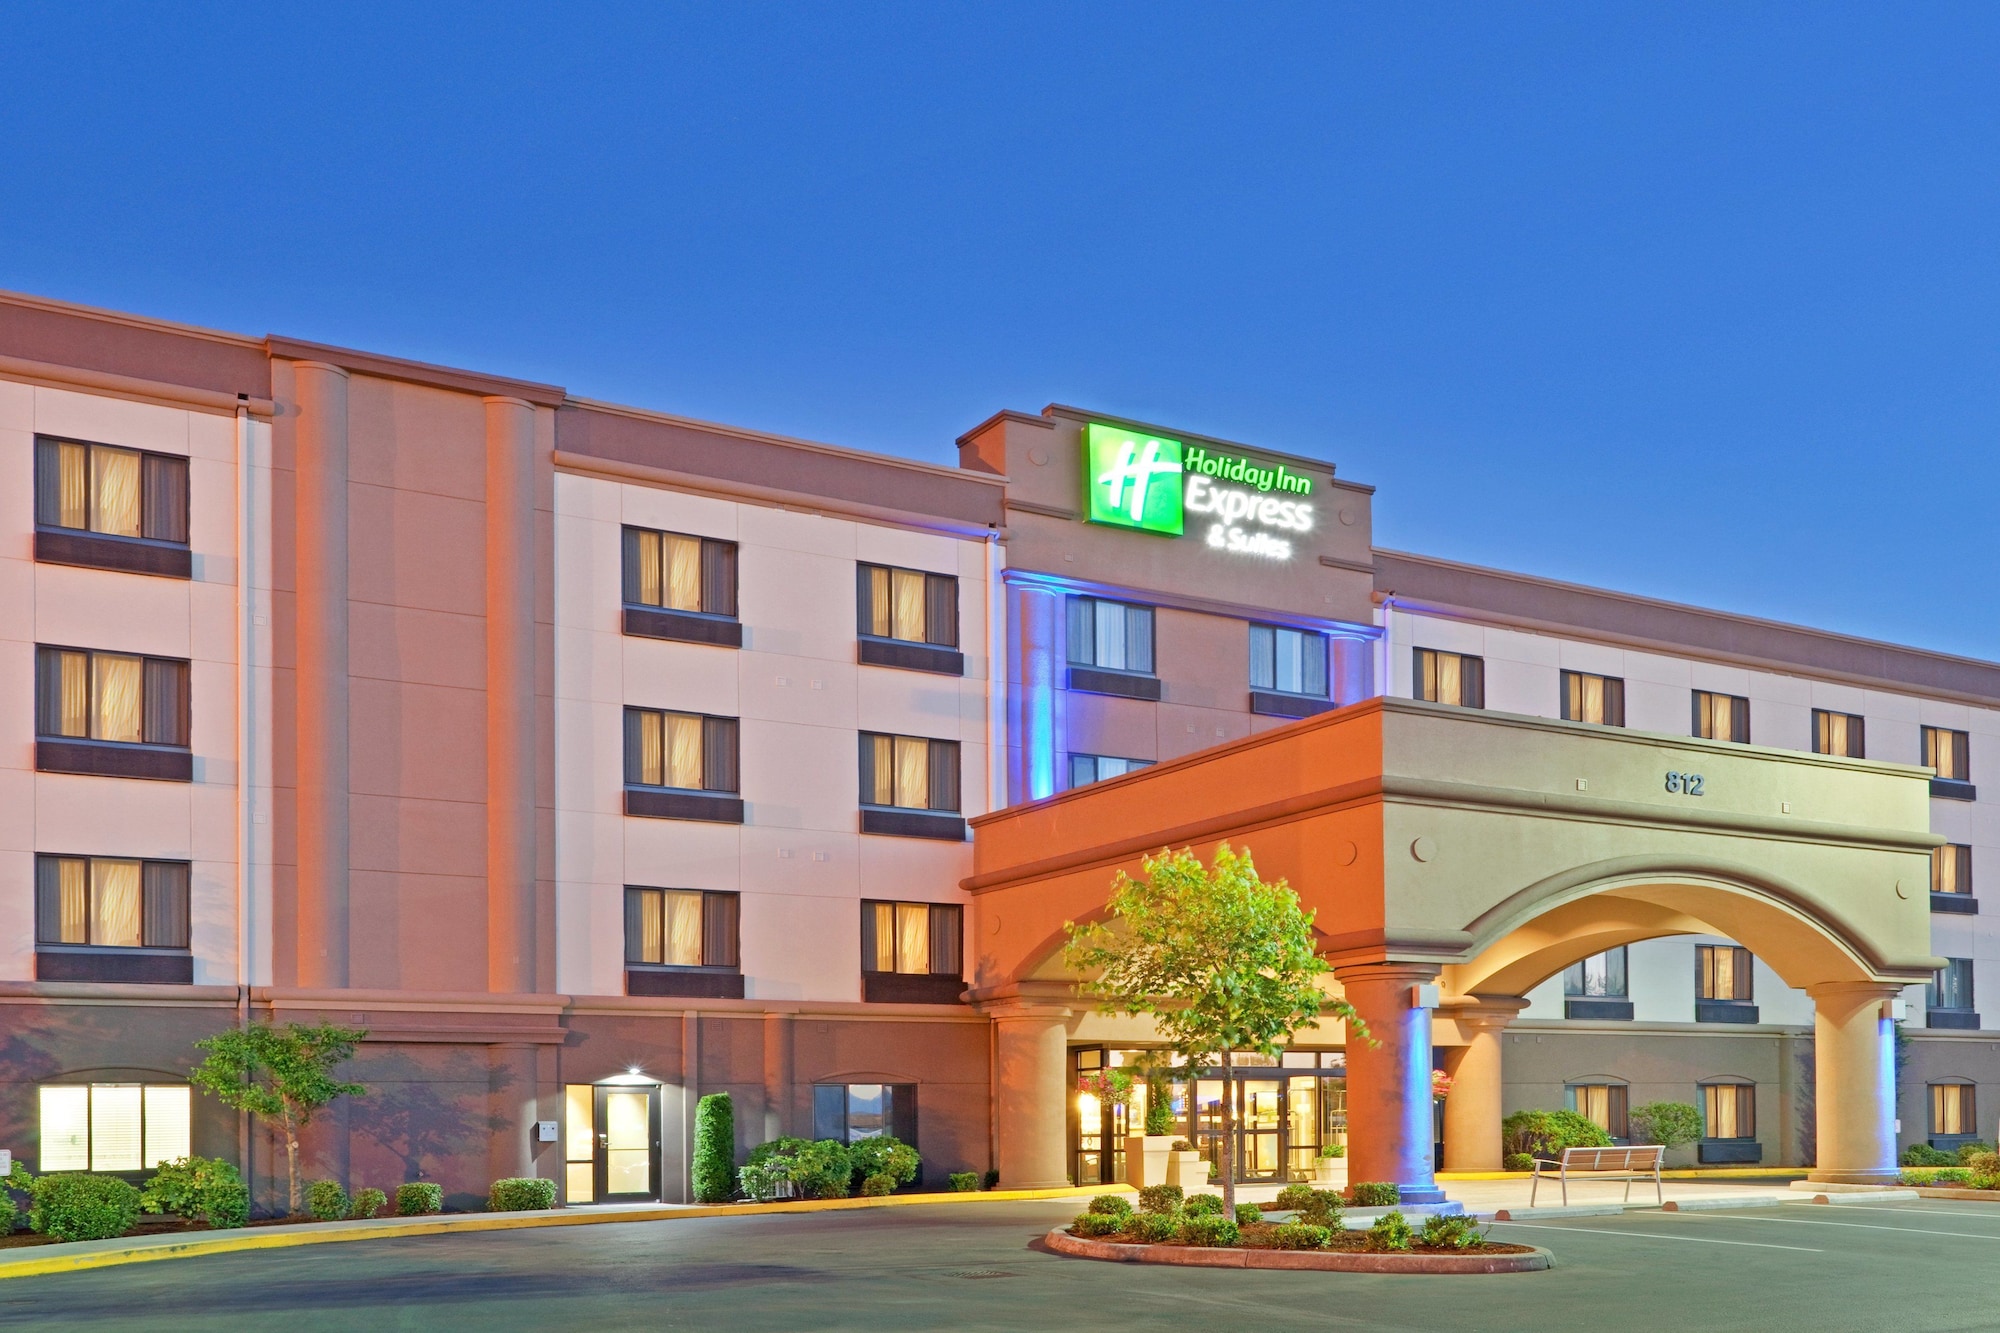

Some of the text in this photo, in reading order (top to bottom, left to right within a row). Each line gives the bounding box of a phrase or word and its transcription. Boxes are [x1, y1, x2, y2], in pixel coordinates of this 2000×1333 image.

[1185, 447, 1311, 495] Holiday Inn
[1185, 475, 1313, 531] Express
[1665, 770, 1705, 796] 812
